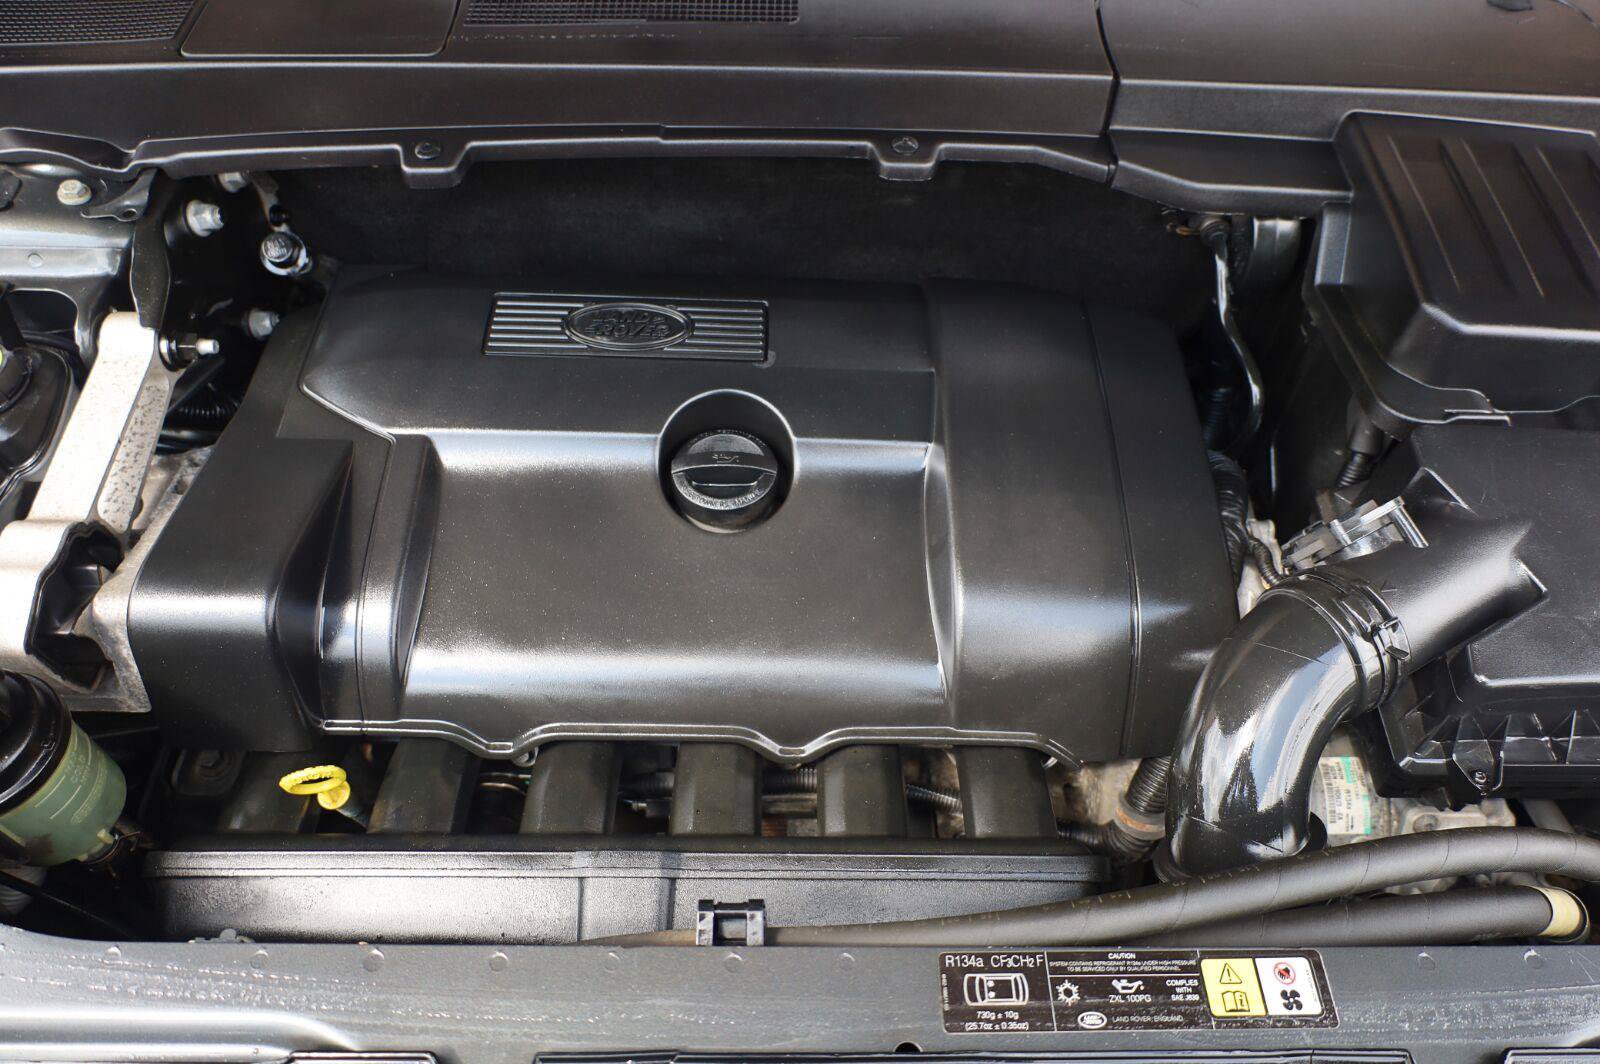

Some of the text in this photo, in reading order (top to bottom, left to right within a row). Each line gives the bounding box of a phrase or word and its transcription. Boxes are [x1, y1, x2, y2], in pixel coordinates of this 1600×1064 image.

[597, 323, 669, 337] ROVER
[945, 954, 984, 967] R134a
[1165, 979, 1199, 987] COMPLIES
[1175, 986, 1192, 994] WITH
[1108, 994, 1152, 1003] ZXL 100PG
[1171, 994, 1184, 1002] SAE
[976, 1010, 995, 1020] 730g
[1004, 1010, 1019, 1020] 10g
[964, 1021, 993, 1031] (25.7oz
